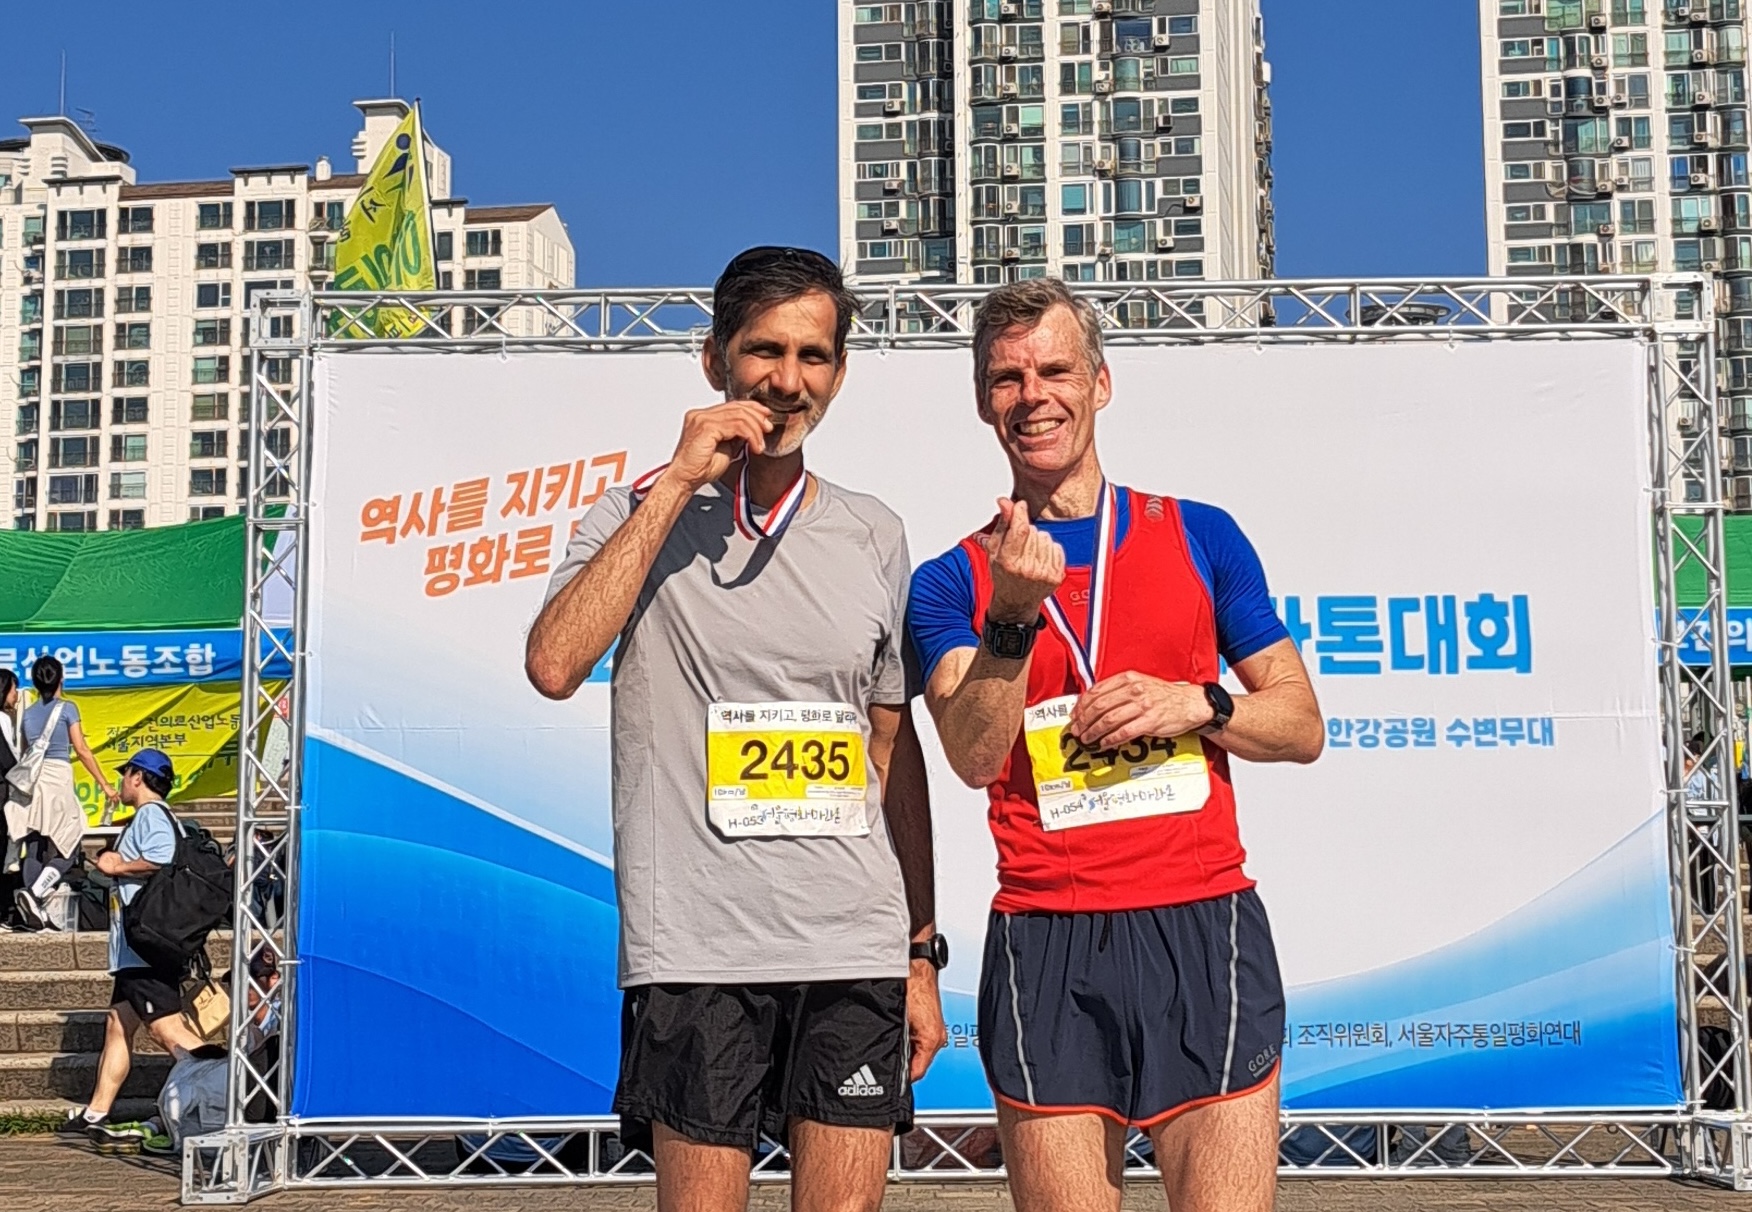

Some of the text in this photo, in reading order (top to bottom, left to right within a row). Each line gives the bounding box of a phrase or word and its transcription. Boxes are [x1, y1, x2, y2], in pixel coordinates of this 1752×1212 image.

[360, 450, 628, 545] 역사를 지키고
[424, 524, 554, 598] 평화로
[720, 709, 756, 723] 역사를
[1327, 717, 1555, 748] 한강공원 수변무대
[739, 739, 850, 781] 2435
[1297, 1021, 1394, 1049] 조직위원회,
[1398, 1019, 1582, 1048] 서울자주통일평화연대
[837, 1083, 884, 1097] adidas
